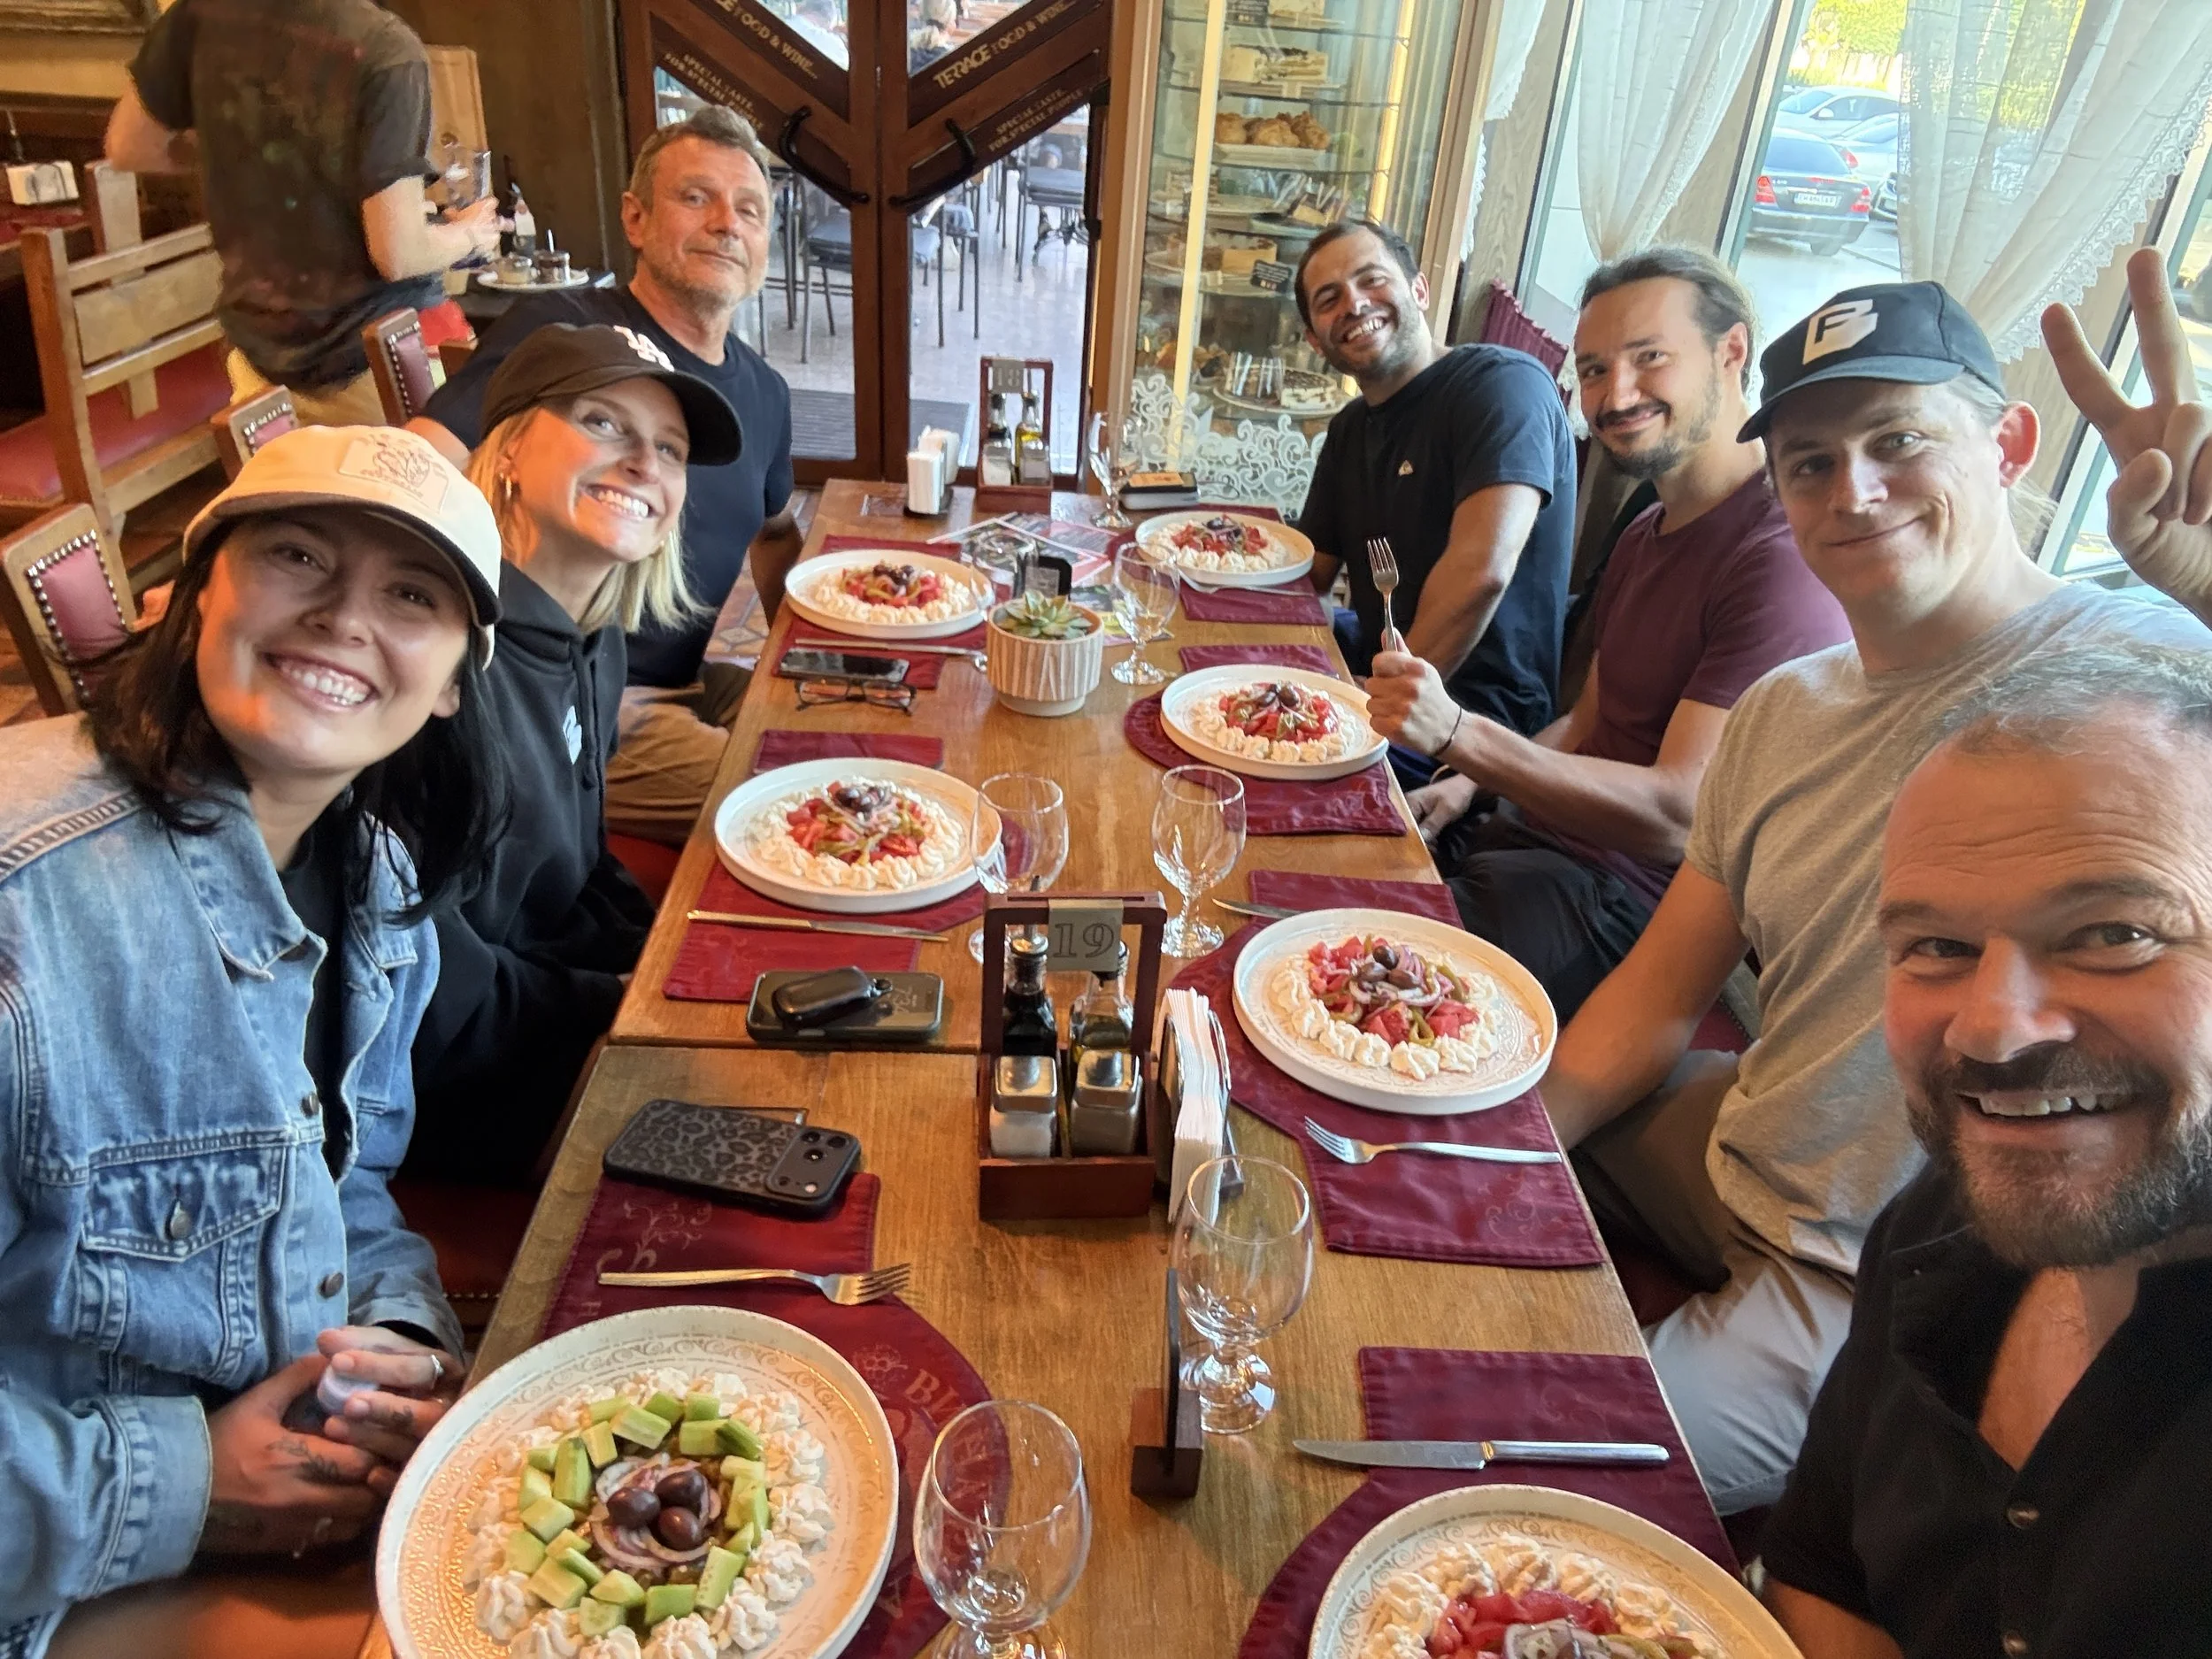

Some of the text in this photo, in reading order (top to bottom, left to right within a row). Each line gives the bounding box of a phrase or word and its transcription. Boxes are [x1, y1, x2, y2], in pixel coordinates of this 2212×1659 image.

[933, 43, 993, 89] TERRACE
[996, 367, 1020, 387] 18
[1053, 923, 1115, 958] 19
